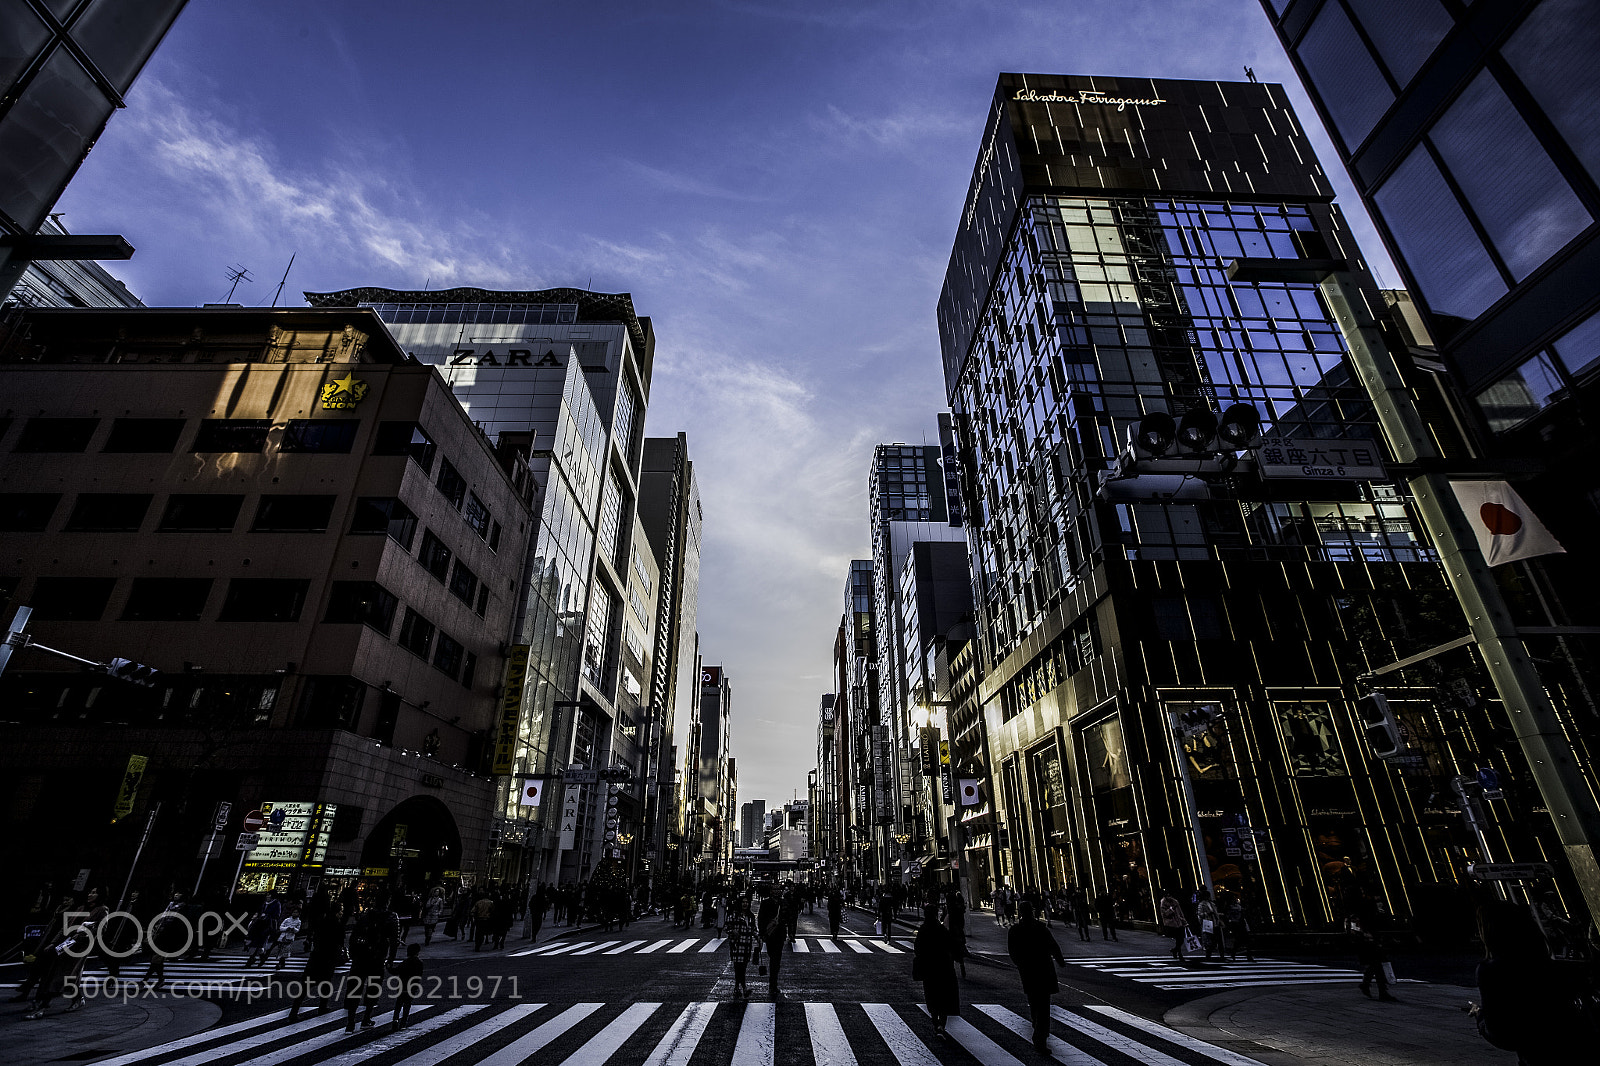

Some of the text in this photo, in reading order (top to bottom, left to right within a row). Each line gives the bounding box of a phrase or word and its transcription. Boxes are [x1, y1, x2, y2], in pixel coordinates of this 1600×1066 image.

[1012, 88, 1167, 112] Salvatore Ferragamo
[450, 349, 563, 366] ZARA
[1262, 438, 1294, 447] 中央区
[1263, 448, 1373, 466] 銀座六丁目
[1302, 466, 1346, 476] Ginza 6
[944, 454, 960, 515] 名鉄観光
[562, 783, 578, 831] ZARA
